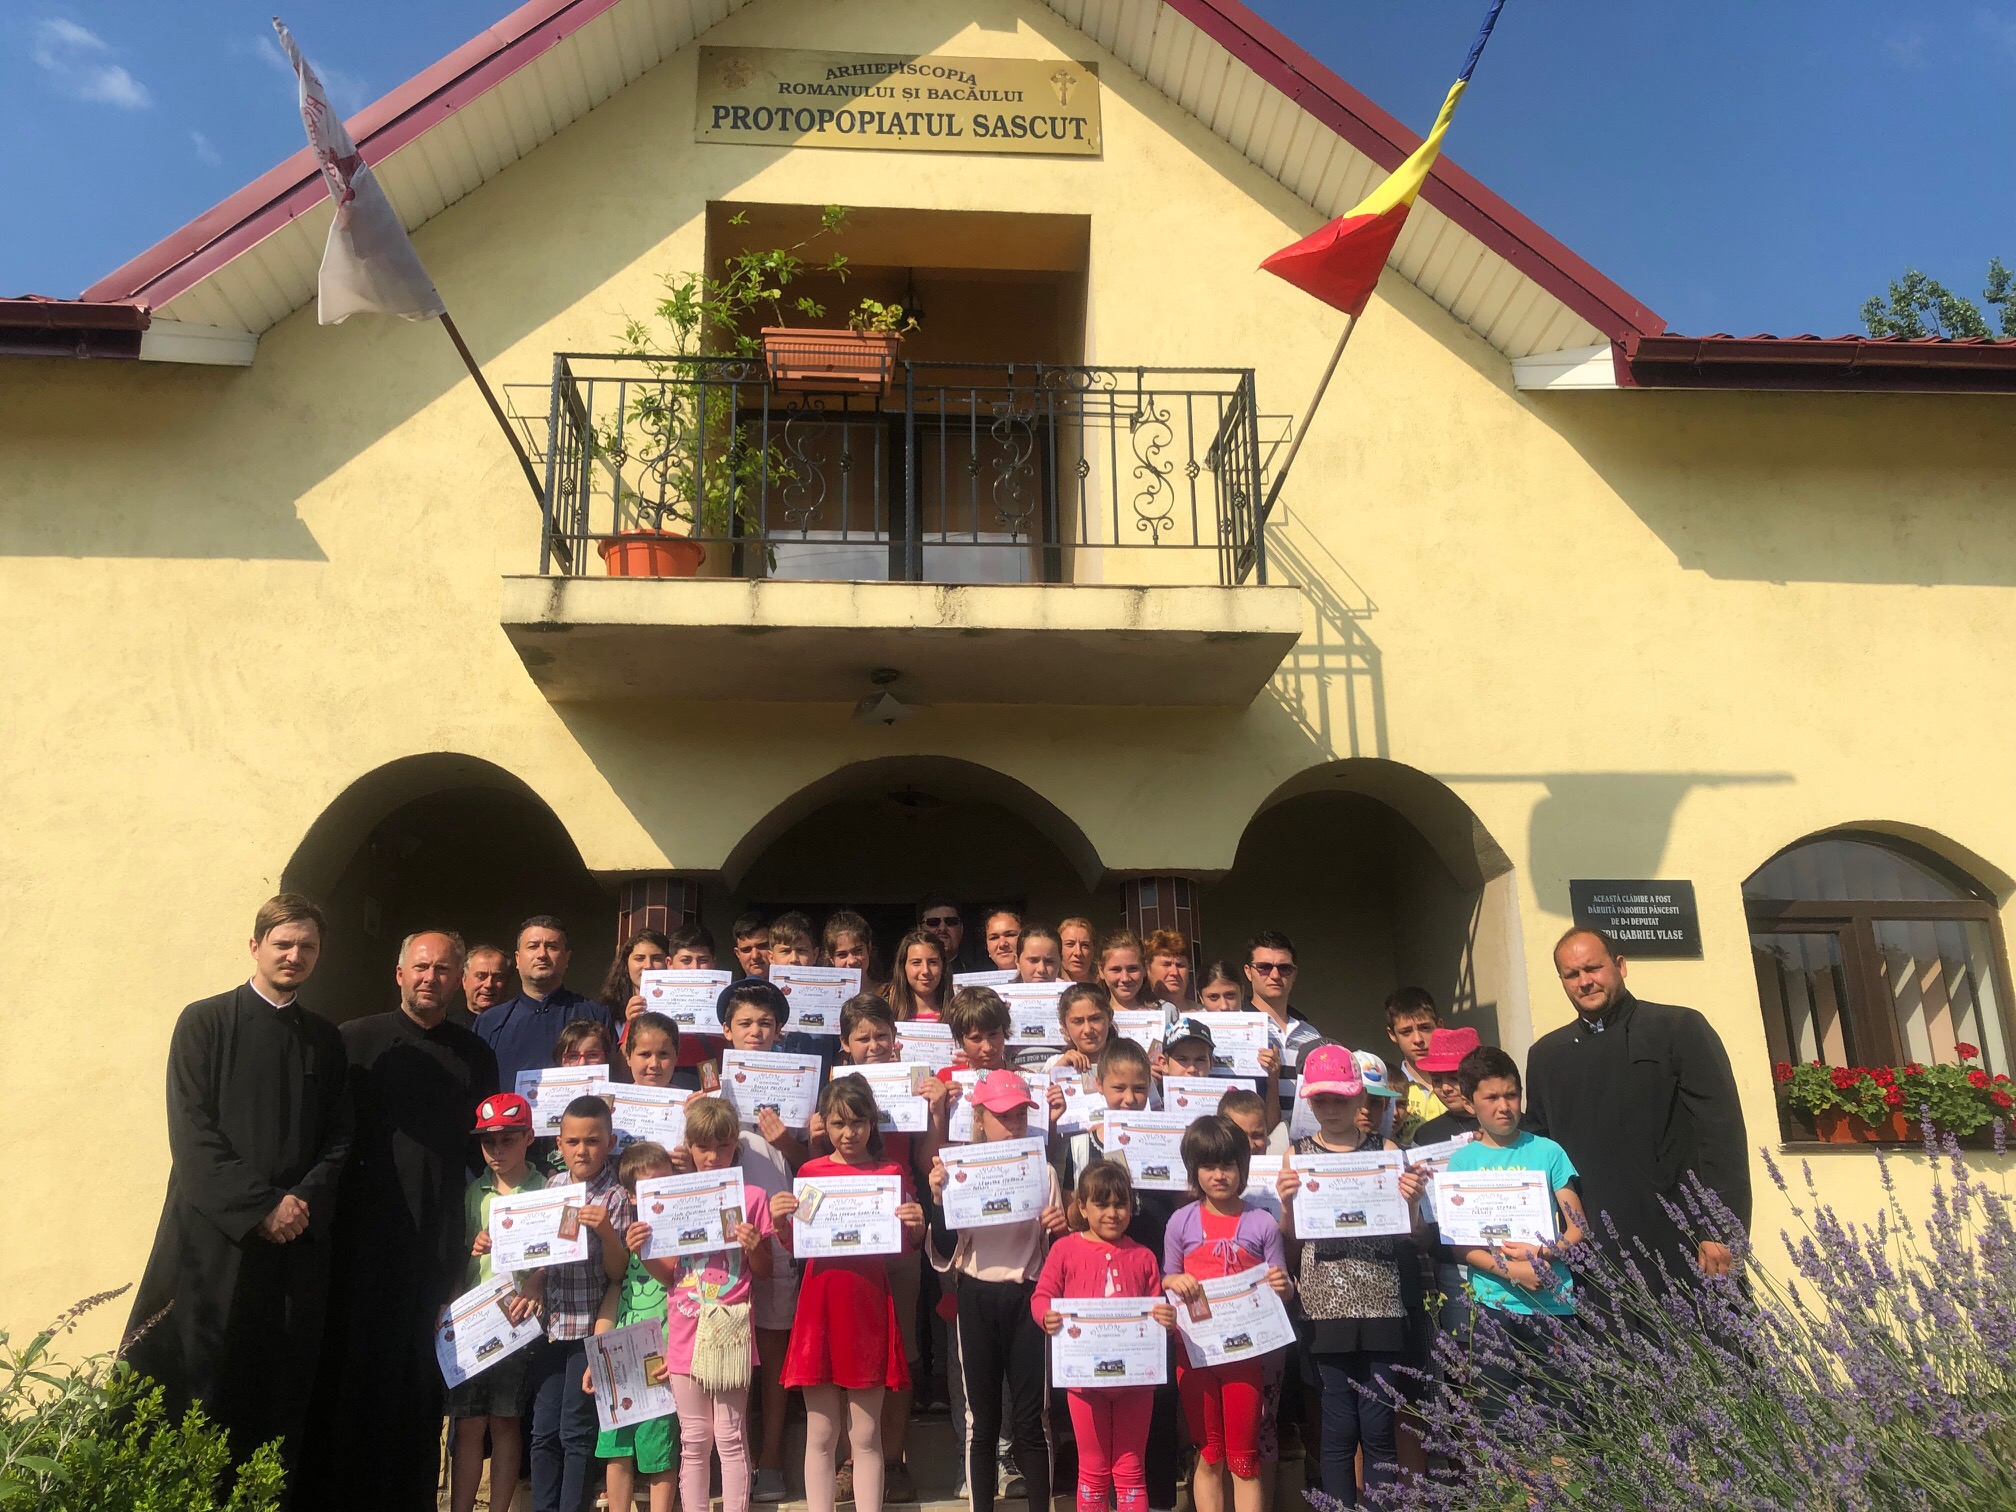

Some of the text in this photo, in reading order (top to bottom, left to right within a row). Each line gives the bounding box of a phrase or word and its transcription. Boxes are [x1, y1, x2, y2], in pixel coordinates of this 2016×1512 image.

[825, 61, 978, 86] ARHIEPISCOPIA
[778, 82, 895, 99] ROMANULUI
[927, 86, 1024, 103] BACĂULUI
[711, 105, 1088, 141] PROTOPOPIATUL SASCUT
[1650, 895, 1655, 903] A
[1655, 895, 1671, 903] FOST
[1617, 906, 1648, 914] PAROHIEI
[1610, 917, 1620, 925] DE
[1631, 917, 1659, 926] DEPUTAT
[1619, 929, 1656, 940] GABRIEL
[1656, 929, 1683, 940] VLASE
